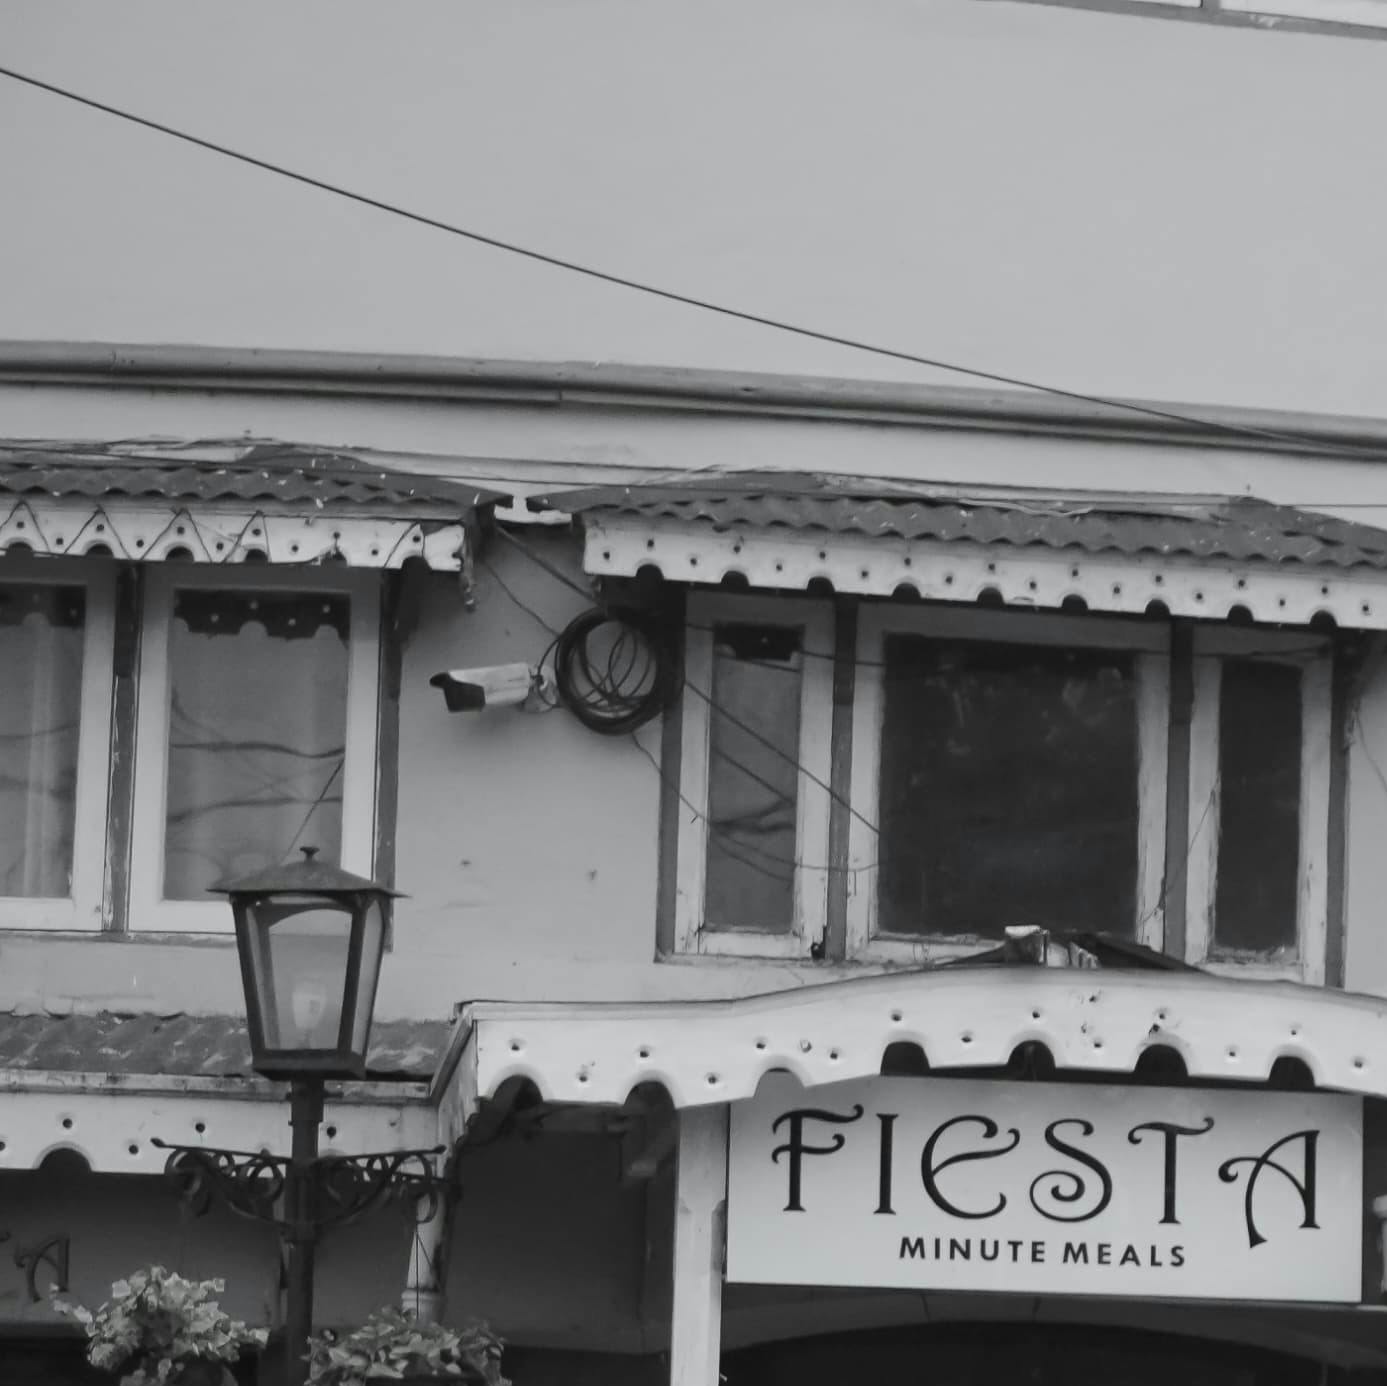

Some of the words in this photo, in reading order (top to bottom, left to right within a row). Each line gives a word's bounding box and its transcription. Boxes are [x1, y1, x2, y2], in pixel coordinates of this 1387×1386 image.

[770, 1103, 1321, 1249] FIESTA
[899, 1236, 1046, 1264] MINUTE
[1062, 1241, 1186, 1269] MEALS
